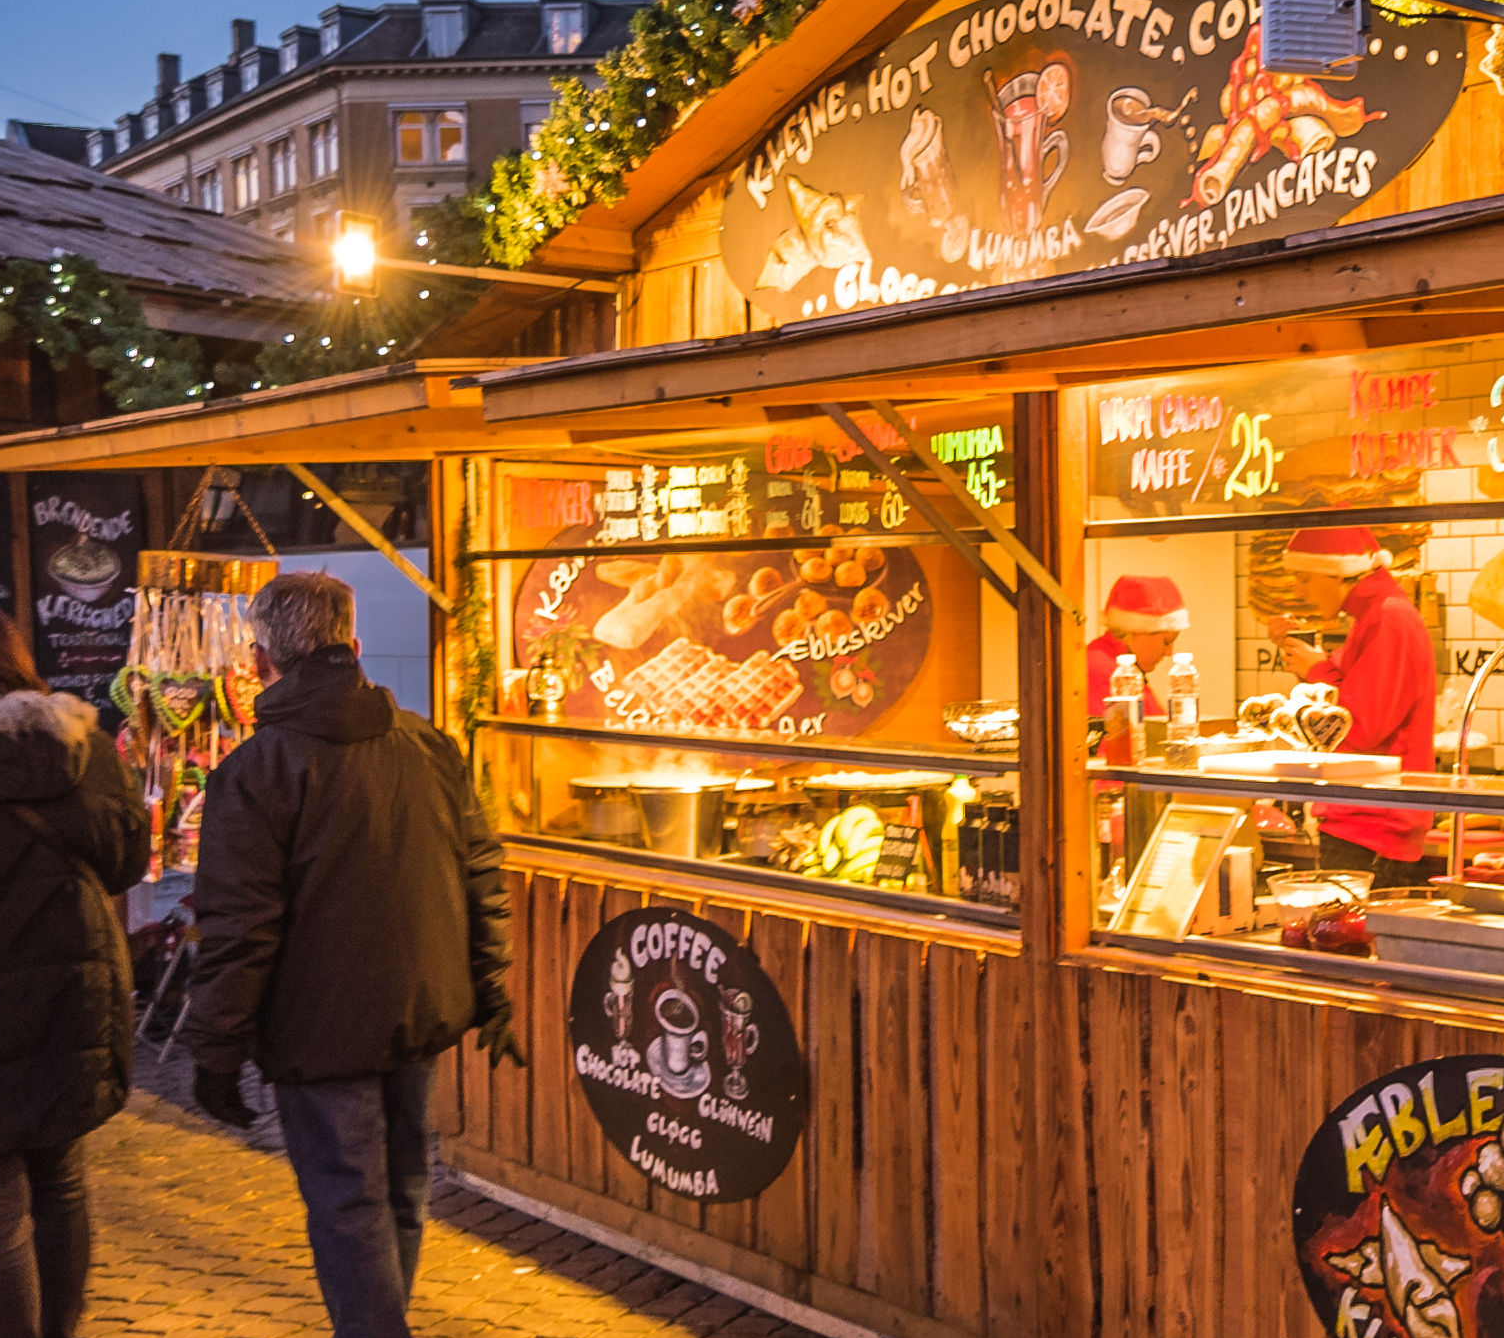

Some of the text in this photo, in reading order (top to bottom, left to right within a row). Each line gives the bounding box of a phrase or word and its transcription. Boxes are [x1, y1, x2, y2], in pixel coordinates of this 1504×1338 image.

[867, 40, 940, 116] HOT
[1225, 147, 1377, 237] PANCAKES
[967, 215, 1083, 272] LUMUMBA
[1130, 447, 1195, 494] KAFFE
[630, 922, 727, 984] COFFEE
[576, 1043, 662, 1100] CHOCOLATE
[629, 1135, 720, 1197] LUMUMBA
